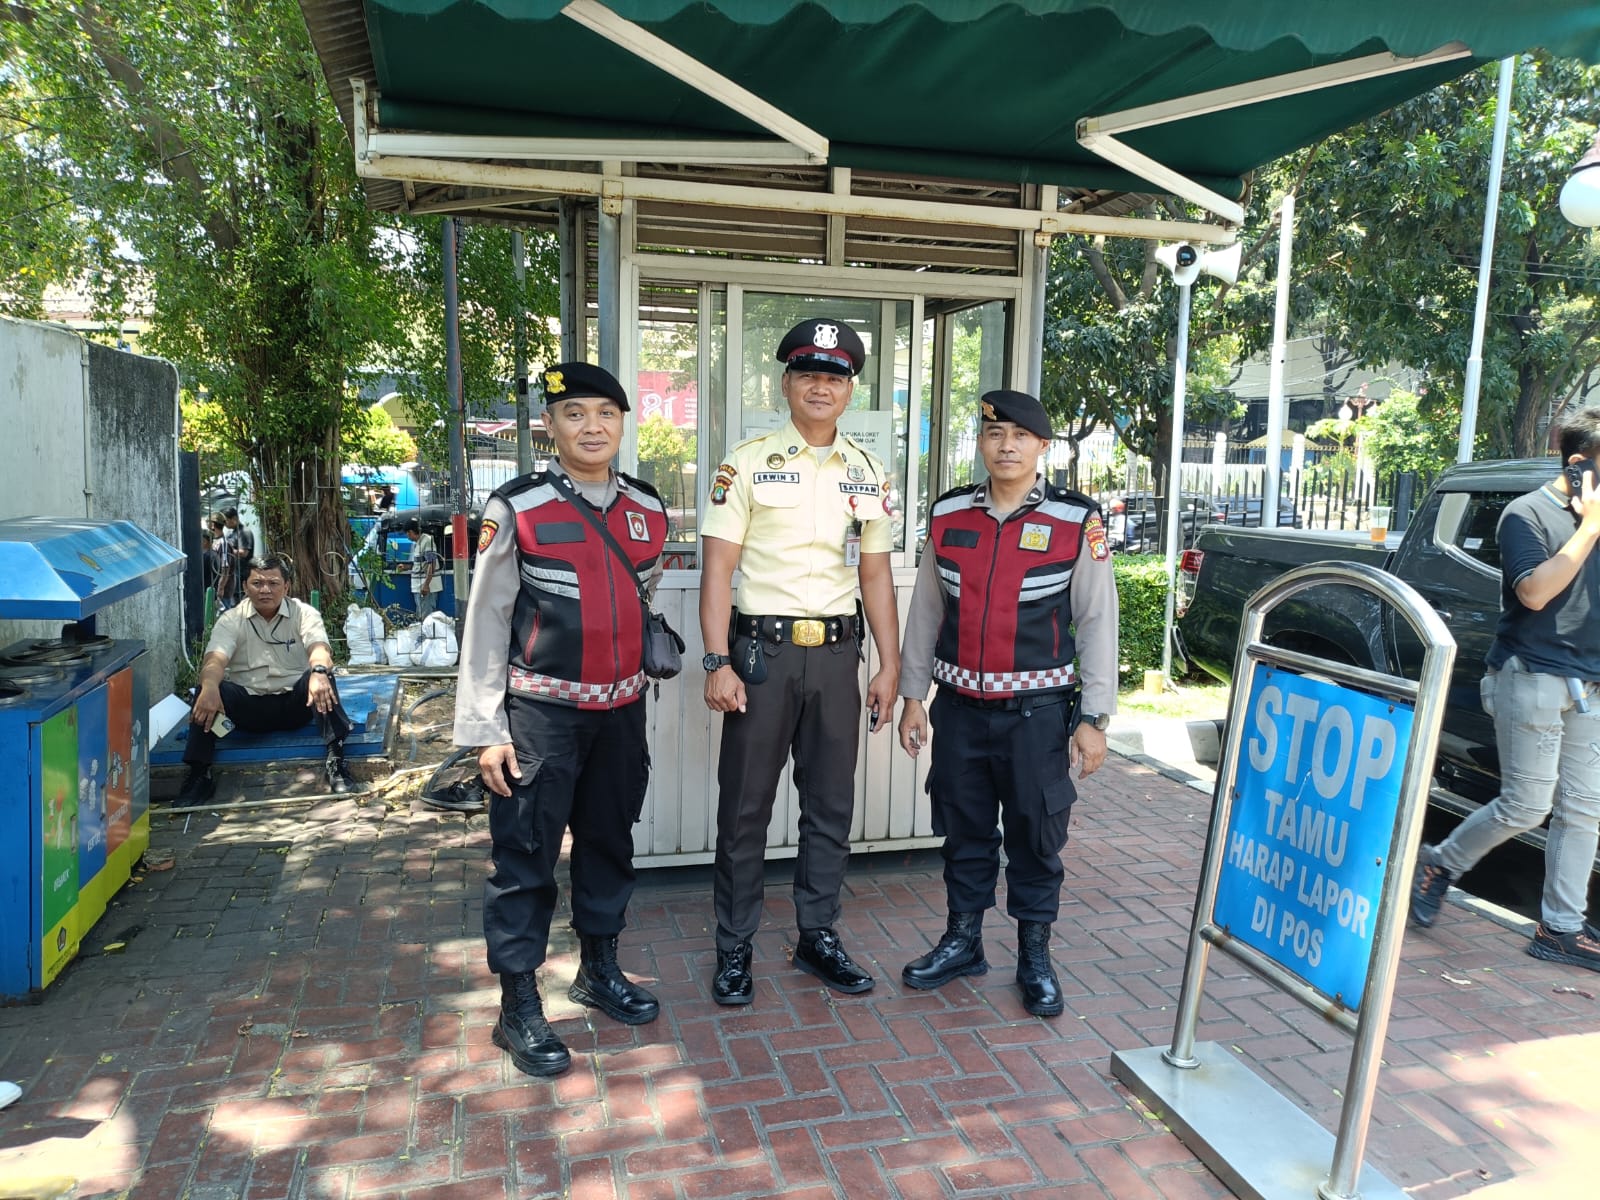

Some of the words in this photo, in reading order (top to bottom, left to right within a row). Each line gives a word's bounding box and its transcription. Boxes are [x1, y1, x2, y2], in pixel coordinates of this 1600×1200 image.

[843, 484, 877, 493] SATPAM
[1248, 685, 1397, 811] STOP
[1265, 790, 1350, 868] TAMU
[1228, 831, 1295, 893] HARAP
[1297, 865, 1370, 939] LAPOR
[1251, 895, 1275, 939] DI
[1278, 911, 1325, 968] POS
